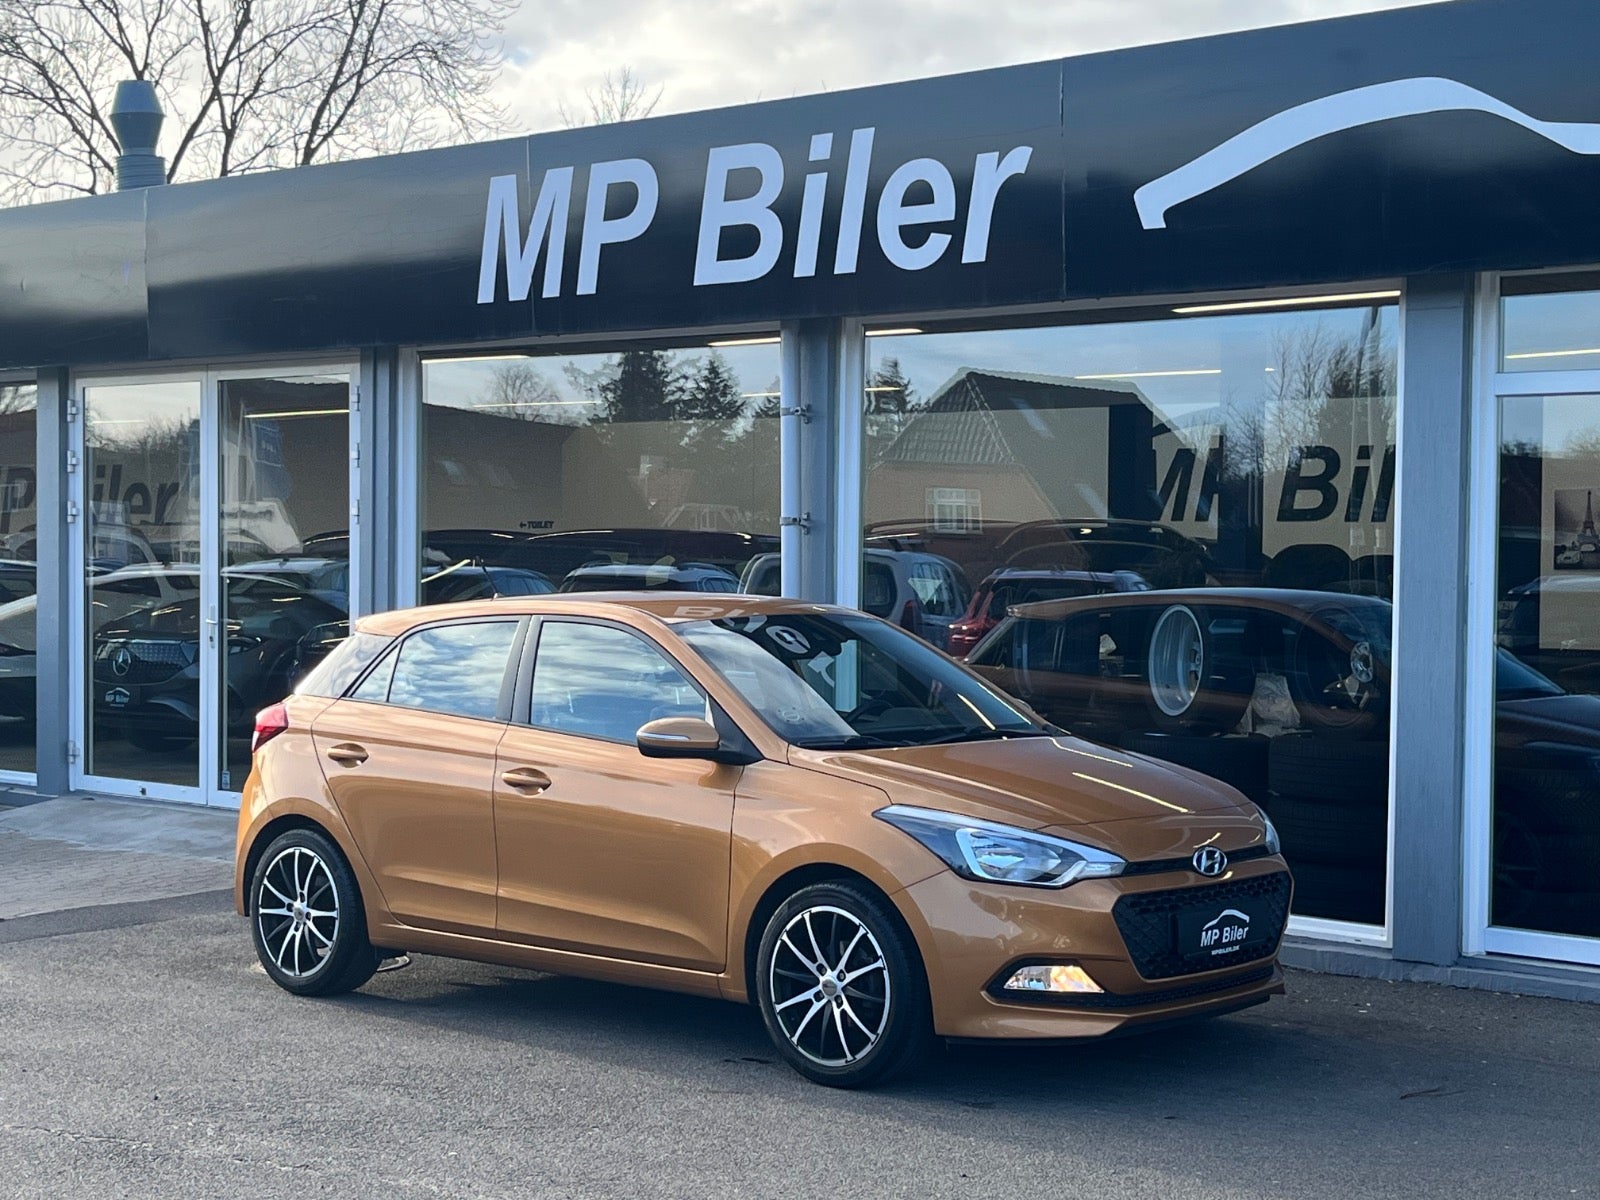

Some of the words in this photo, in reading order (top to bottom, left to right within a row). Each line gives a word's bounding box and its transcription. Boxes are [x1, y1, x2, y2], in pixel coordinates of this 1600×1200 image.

[477, 158, 659, 304] MP
[693, 127, 1033, 286] Biler
[91, 464, 180, 524] iler
[1276, 445, 1396, 522] Bil
[1200, 929, 1220, 947] MP
[1222, 925, 1249, 943] Biler
